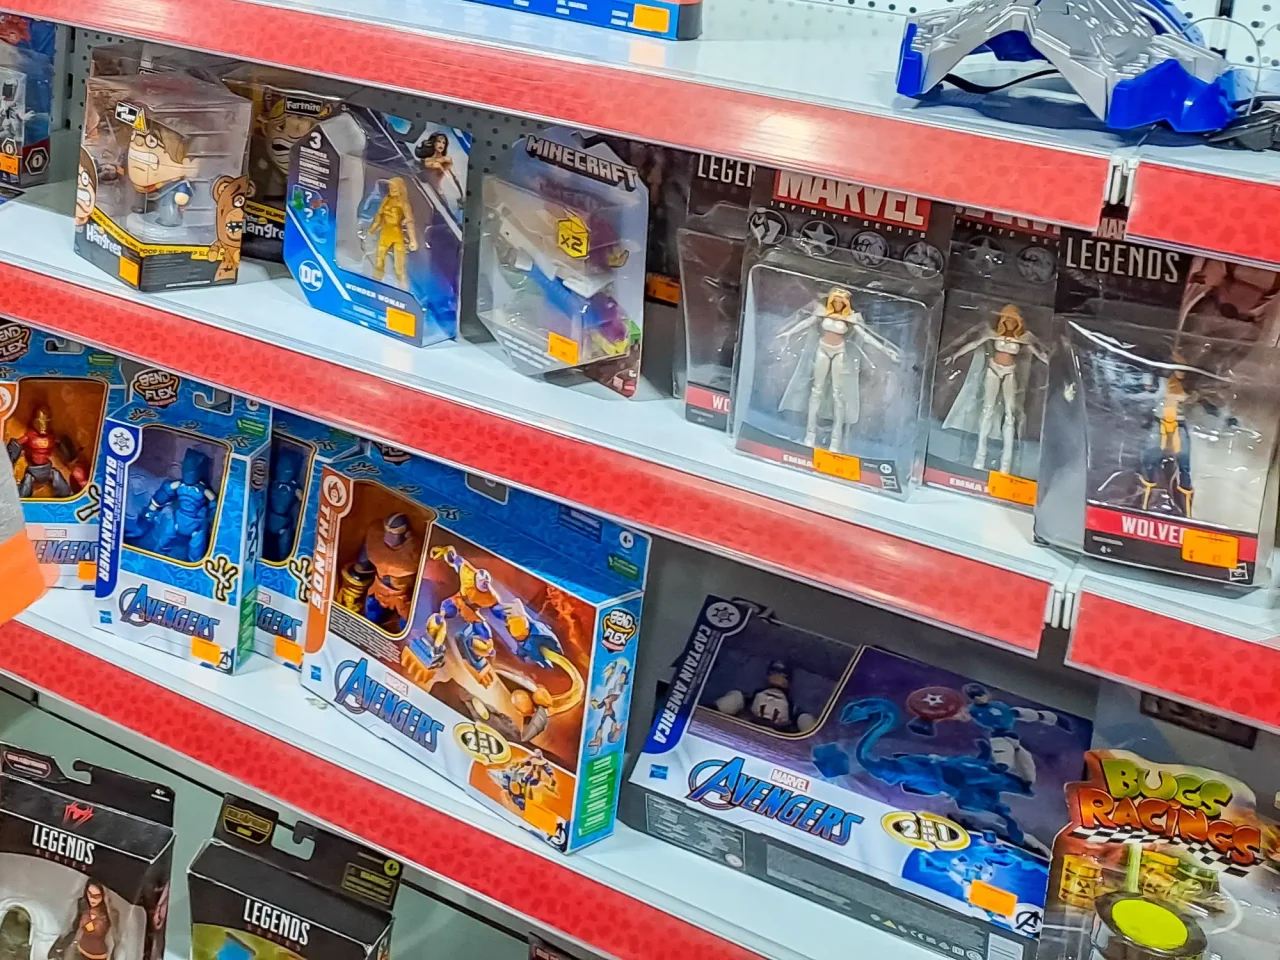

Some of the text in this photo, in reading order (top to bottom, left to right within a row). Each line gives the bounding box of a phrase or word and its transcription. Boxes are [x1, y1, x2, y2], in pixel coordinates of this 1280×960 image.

[310, 132, 322, 149] 3
[526, 135, 638, 191] MINECRAFT
[697, 154, 755, 187] LEGEN
[777, 170, 925, 226] MARVEL
[243, 222, 285, 240] angre
[770, 201, 926, 239] INFINITE SERIES
[956, 219, 1016, 237] FINITE
[1066, 237, 1181, 284] LEGENDS
[300, 269, 322, 288] DC
[138, 372, 170, 387] BEND
[145, 386, 176, 401] FLEX
[783, 453, 814, 468] EMMA
[949, 477, 982, 492] EMMA
[99, 455, 115, 582] BLACK PANTHER
[1121, 515, 1187, 545] WOLVE
[36, 539, 98, 565] ENGERS
[311, 505, 331, 610] THANOS
[119, 583, 220, 642] AVENGERS
[610, 610, 633, 628] BEND
[604, 627, 628, 646] FLEX
[653, 624, 711, 745] CAPTAIN AMERICA
[334, 657, 445, 753] AVENGERS
[772, 769, 810, 791] MARVEL
[1101, 758, 1233, 817] BUGS
[685, 756, 865, 846] AVENGERS
[32, 824, 95, 865] LEGENDS
[243, 899, 310, 946] LEGENDS
